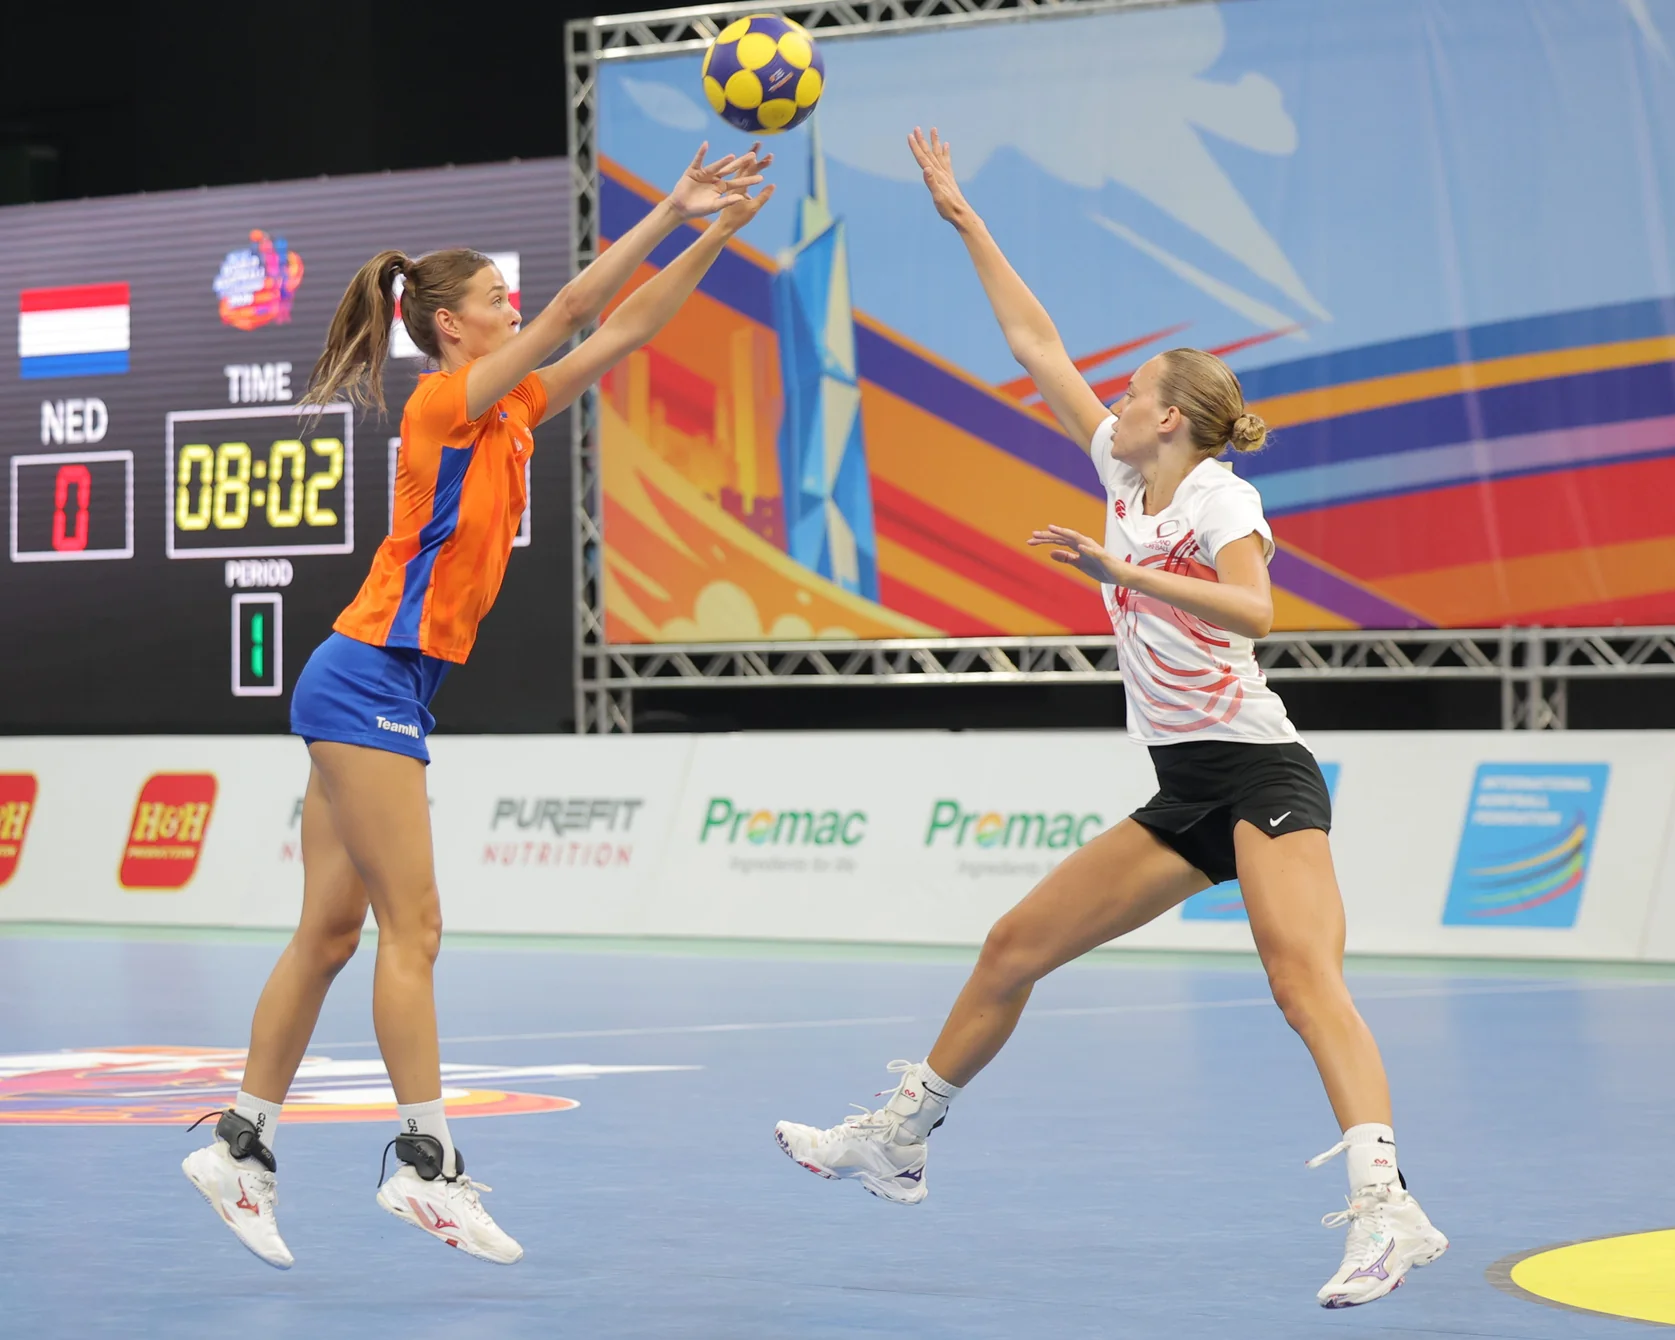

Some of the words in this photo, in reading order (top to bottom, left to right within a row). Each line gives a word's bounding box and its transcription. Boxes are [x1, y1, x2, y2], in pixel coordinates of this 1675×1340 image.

[224, 362, 293, 403] TIME
[41, 398, 108, 445] NED
[176, 438, 343, 531] 08:02
[52, 464, 91, 551] 0
[225, 559, 293, 588] PERIOD
[251, 612, 263, 678] 1
[376, 716, 419, 739] TeamNL
[134, 802, 209, 841] H&H
[490, 797, 643, 836] PUREFIT
[699, 797, 868, 845] Promac
[924, 799, 1103, 848] Promac
[482, 841, 633, 868] NUTRITION
